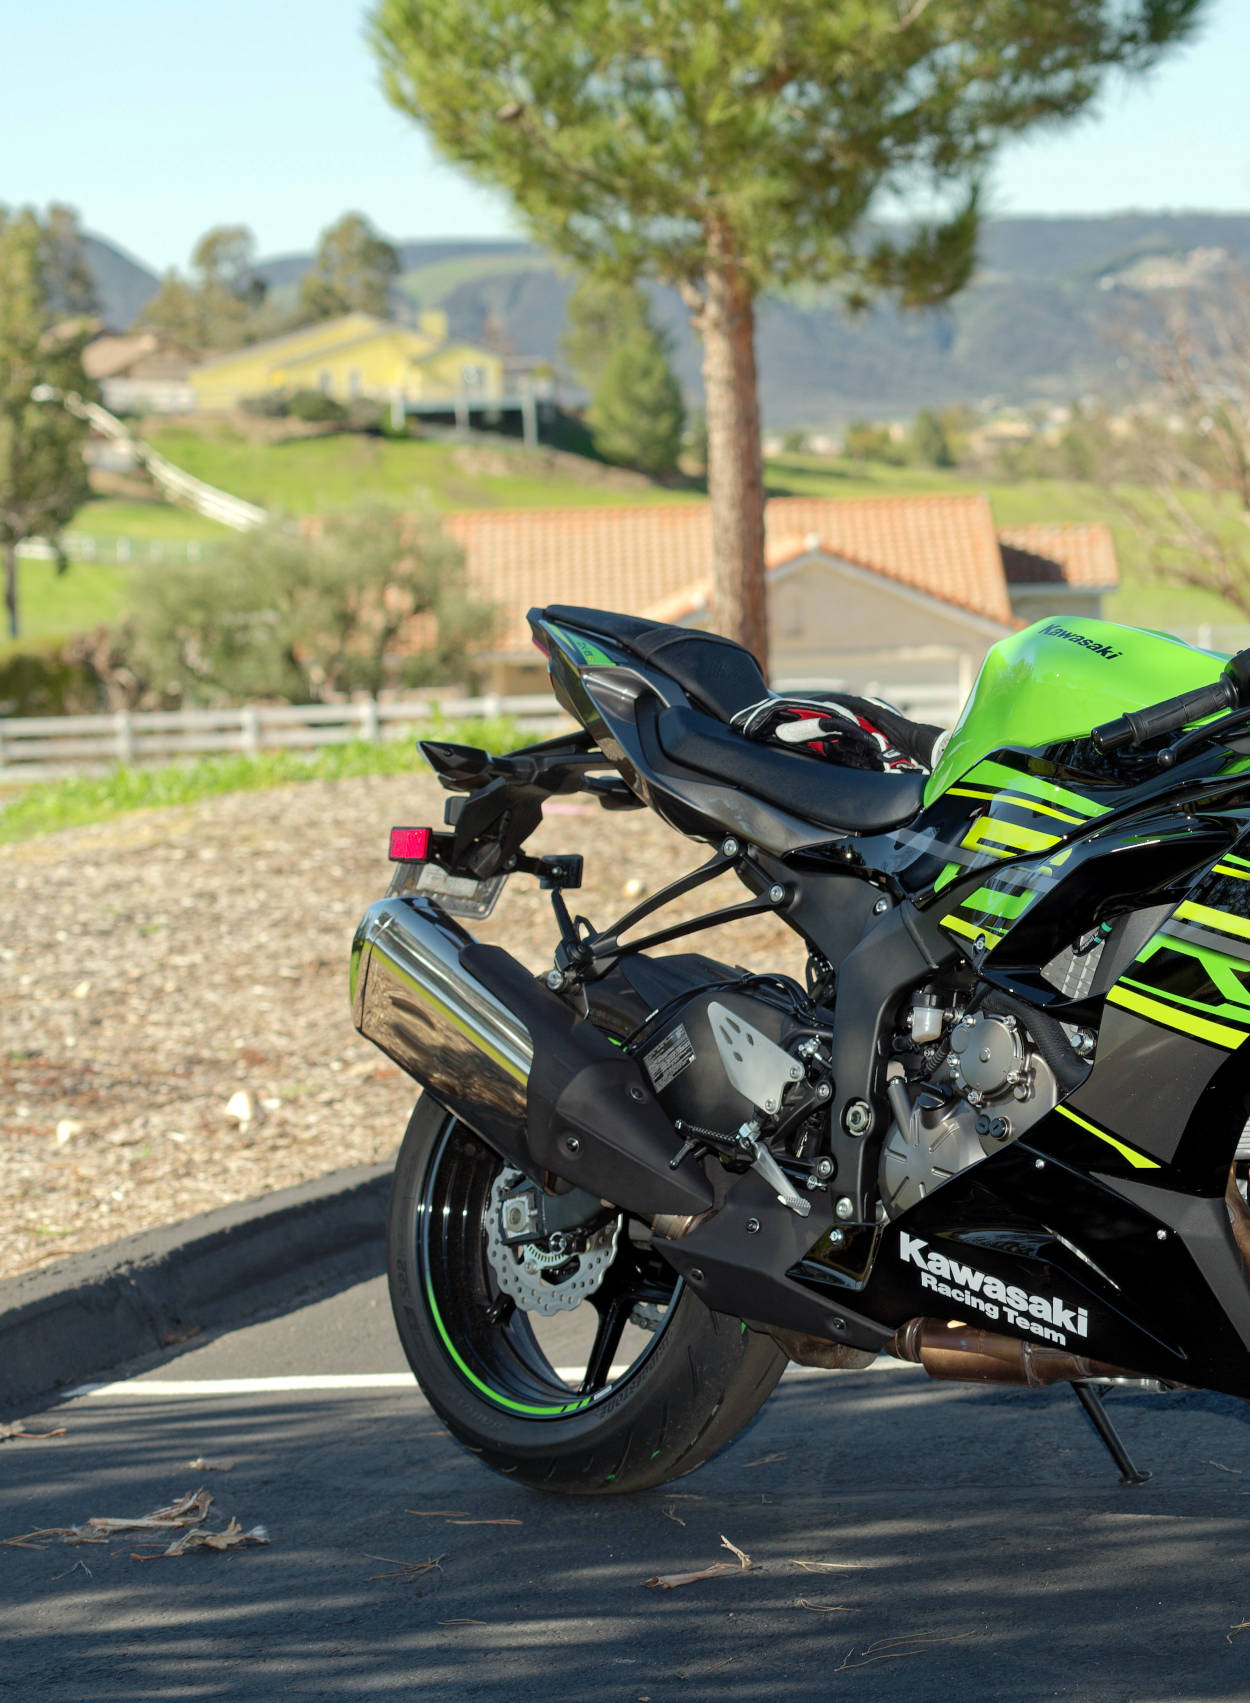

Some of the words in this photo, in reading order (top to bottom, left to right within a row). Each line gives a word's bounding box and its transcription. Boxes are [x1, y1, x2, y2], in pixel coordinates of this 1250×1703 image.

[1038, 623, 1123, 660] Kawasaki
[900, 1230, 1088, 1338] Kawasaki
[920, 1271, 1000, 1320] Racing
[1002, 1306, 1067, 1346] Team
